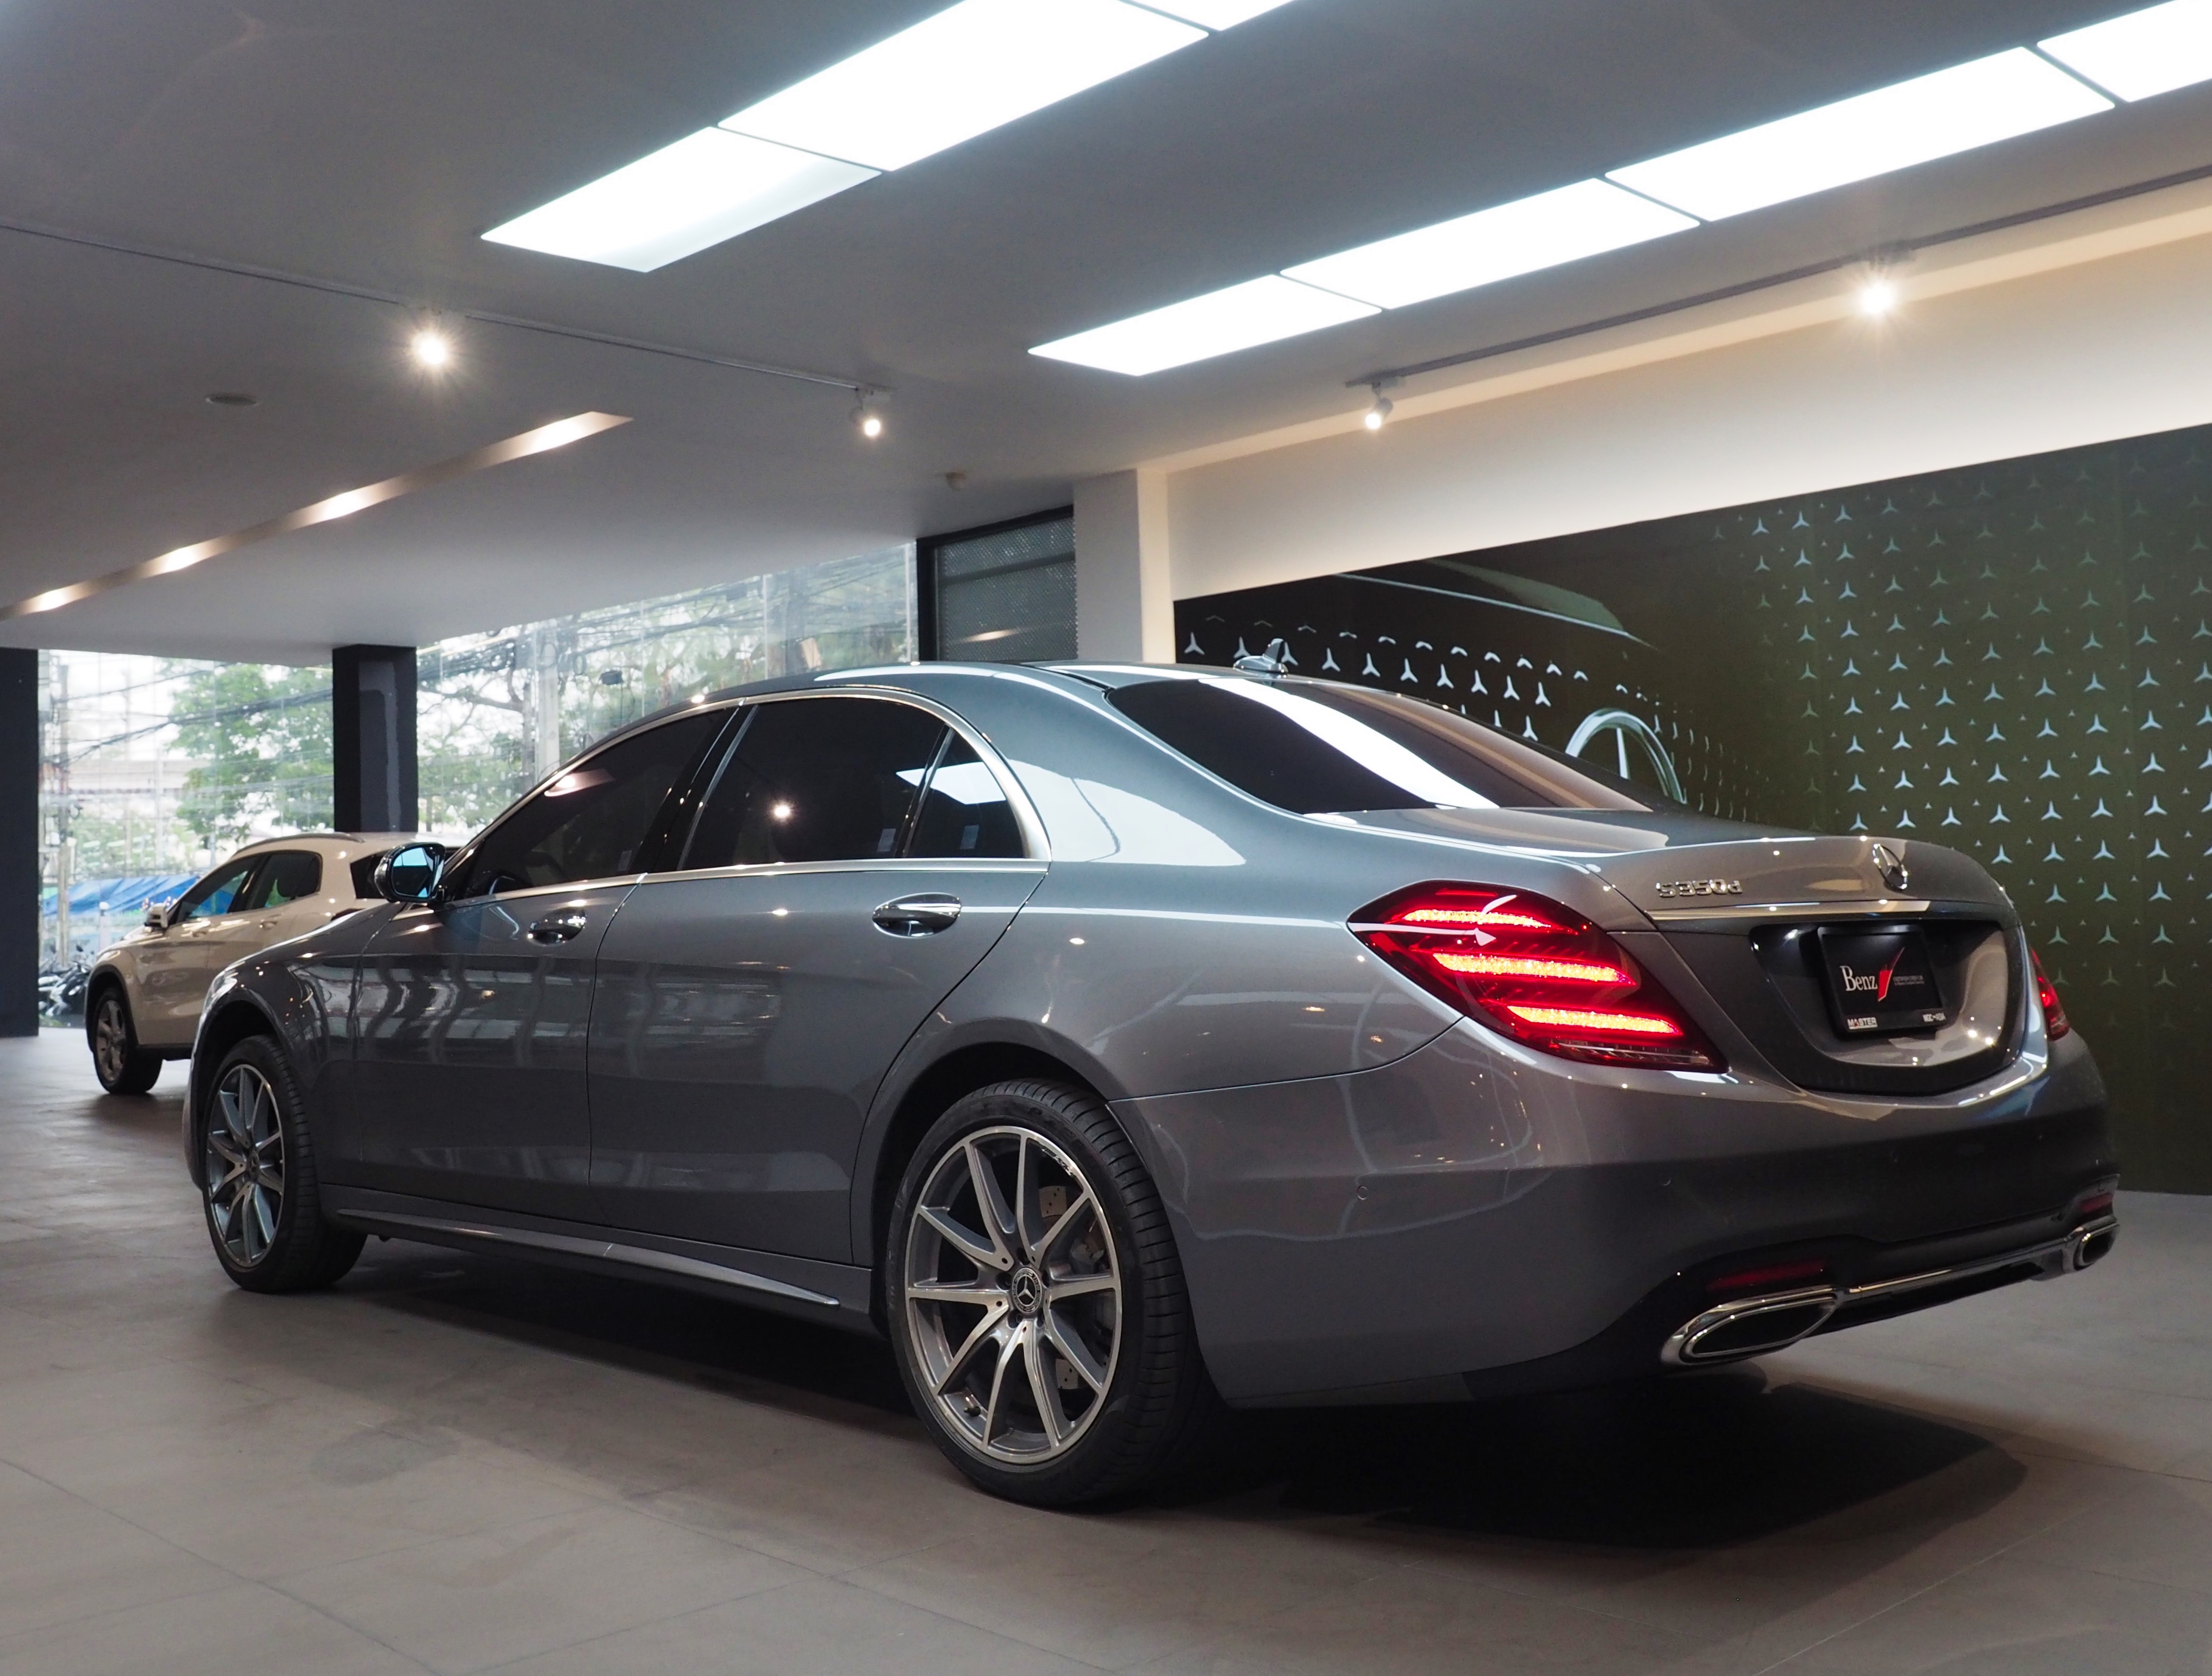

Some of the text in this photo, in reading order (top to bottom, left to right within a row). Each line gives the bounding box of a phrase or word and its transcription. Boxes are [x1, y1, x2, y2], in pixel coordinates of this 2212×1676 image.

[1656, 879, 1743, 897] S350d
[1839, 966, 1878, 991] Benz
[1847, 1017, 1877, 1027] MASTER
